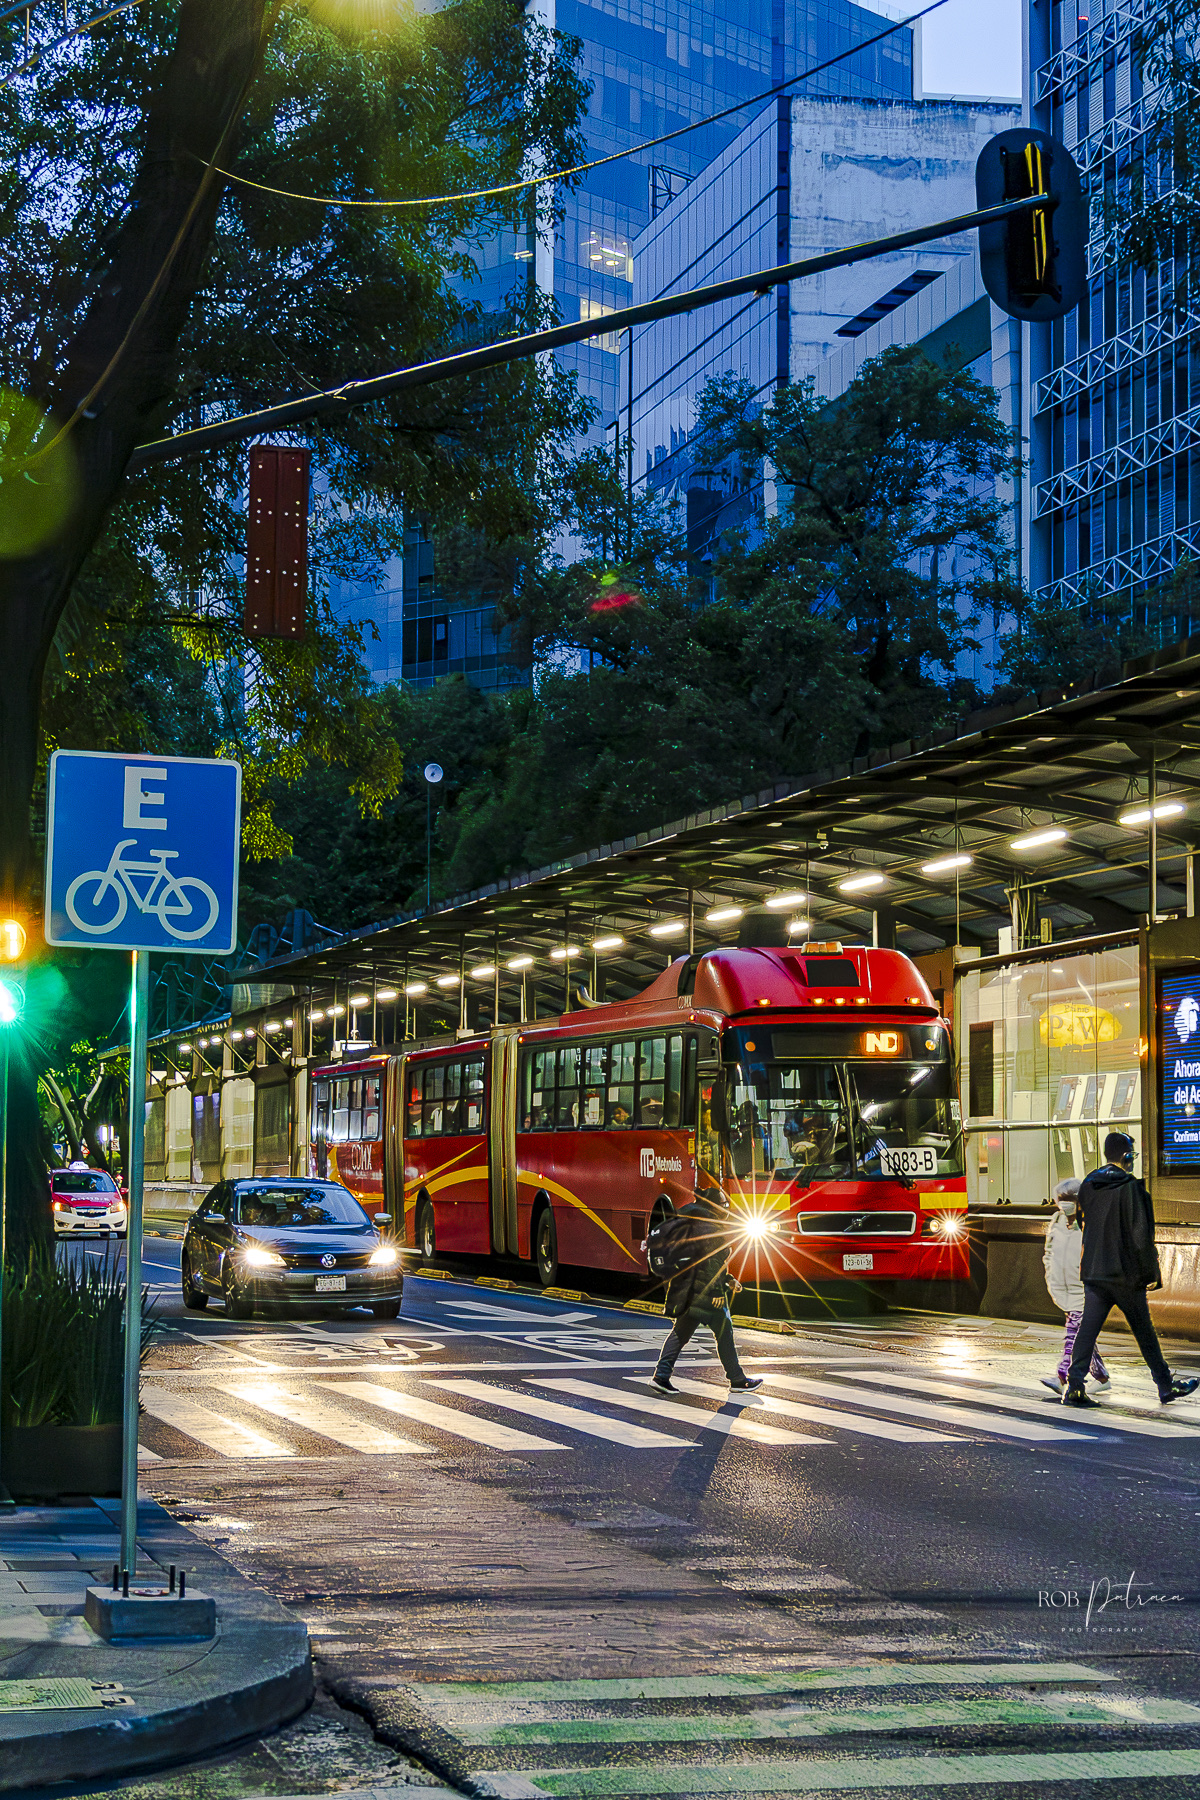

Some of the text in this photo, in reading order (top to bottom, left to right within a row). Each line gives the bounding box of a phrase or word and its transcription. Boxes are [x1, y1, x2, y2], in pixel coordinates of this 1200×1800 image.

[123, 766, 168, 831] E
[1049, 1015, 1064, 1040] P
[1075, 1016, 1106, 1040] W
[865, 1032, 898, 1053] ND
[1173, 1059, 1200, 1078] Ahora
[1173, 1086, 1188, 1105] del
[655, 1155, 683, 1172] Metrobús
[884, 1150, 934, 1172] 1083-B
